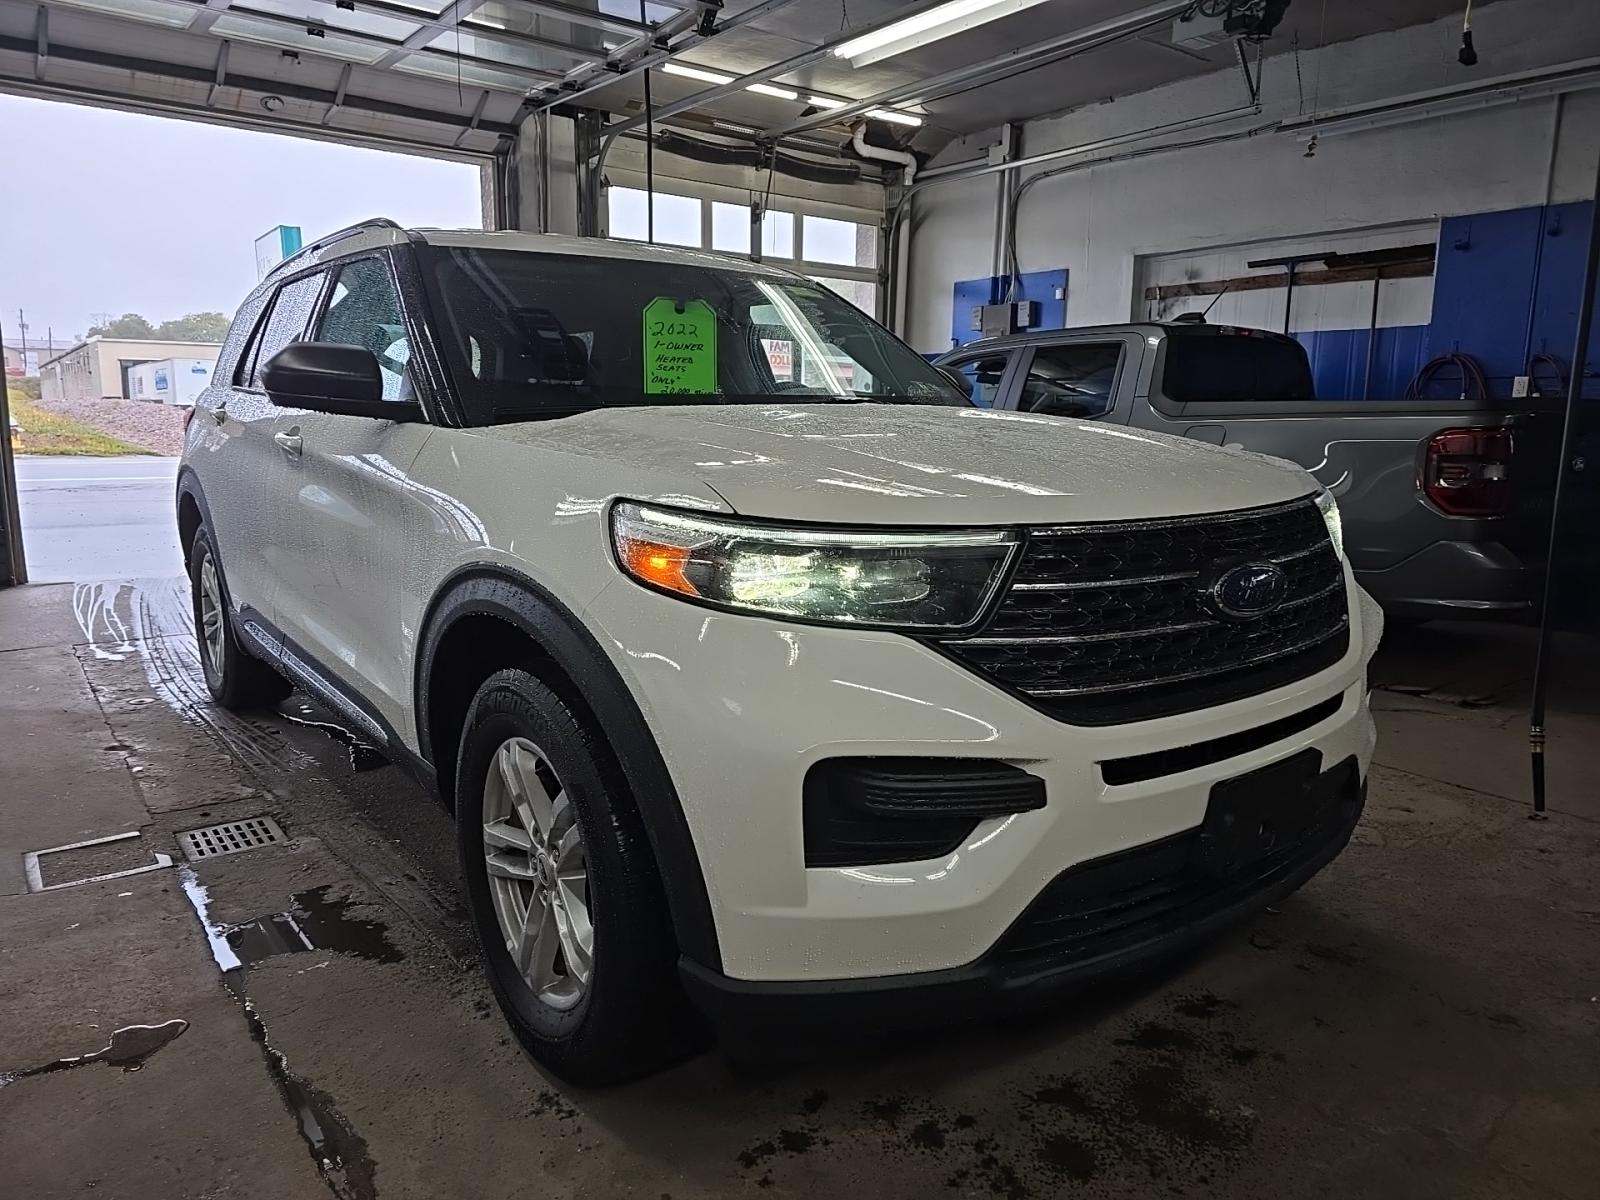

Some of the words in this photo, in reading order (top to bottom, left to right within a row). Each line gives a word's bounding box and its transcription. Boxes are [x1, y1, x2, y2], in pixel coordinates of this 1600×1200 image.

[652, 322, 698, 337] 2022
[654, 341, 704, 351] 1-OWNER
[656, 354, 694, 364] HEATED
[656, 364, 687, 373] SEATS
